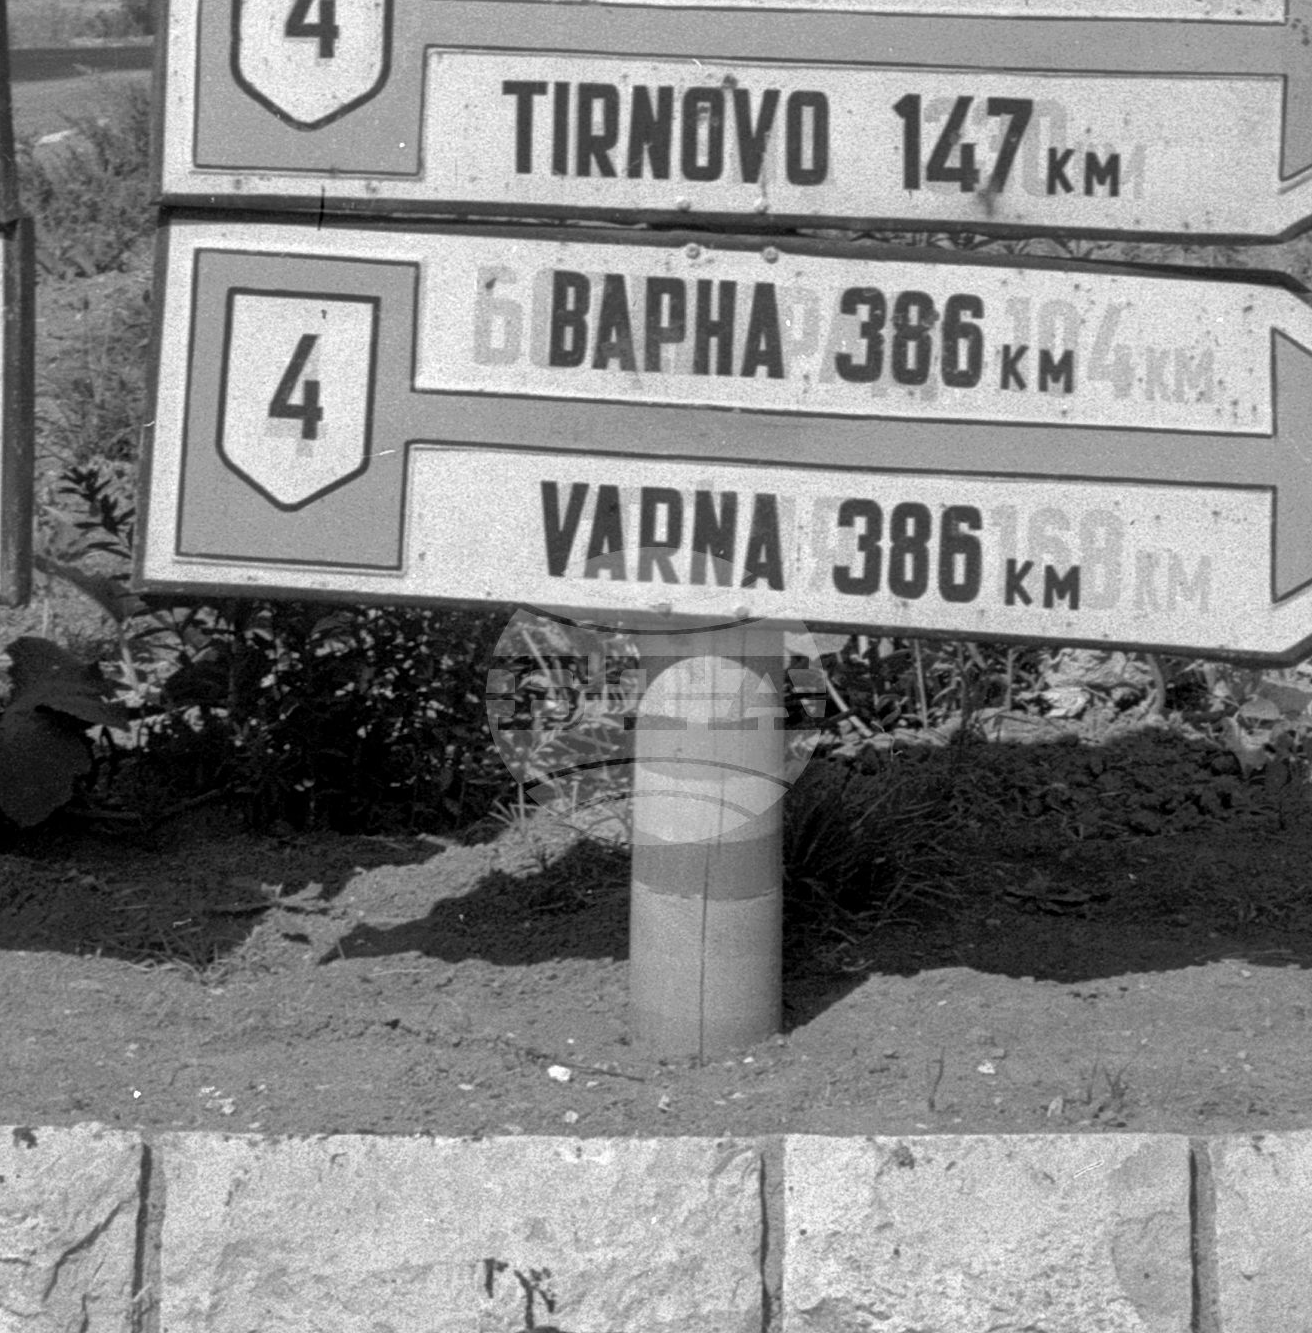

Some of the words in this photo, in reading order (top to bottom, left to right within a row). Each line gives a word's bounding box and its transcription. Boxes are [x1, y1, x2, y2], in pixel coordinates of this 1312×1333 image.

[503, 80, 829, 186] TIRNOVO
[893, 94, 1034, 194] 147
[269, 334, 322, 440] 4
[549, 270, 784, 379] ВАРНА
[835, 287, 983, 388] 386
[541, 481, 784, 591] VARNA
[833, 498, 982, 603] 386
